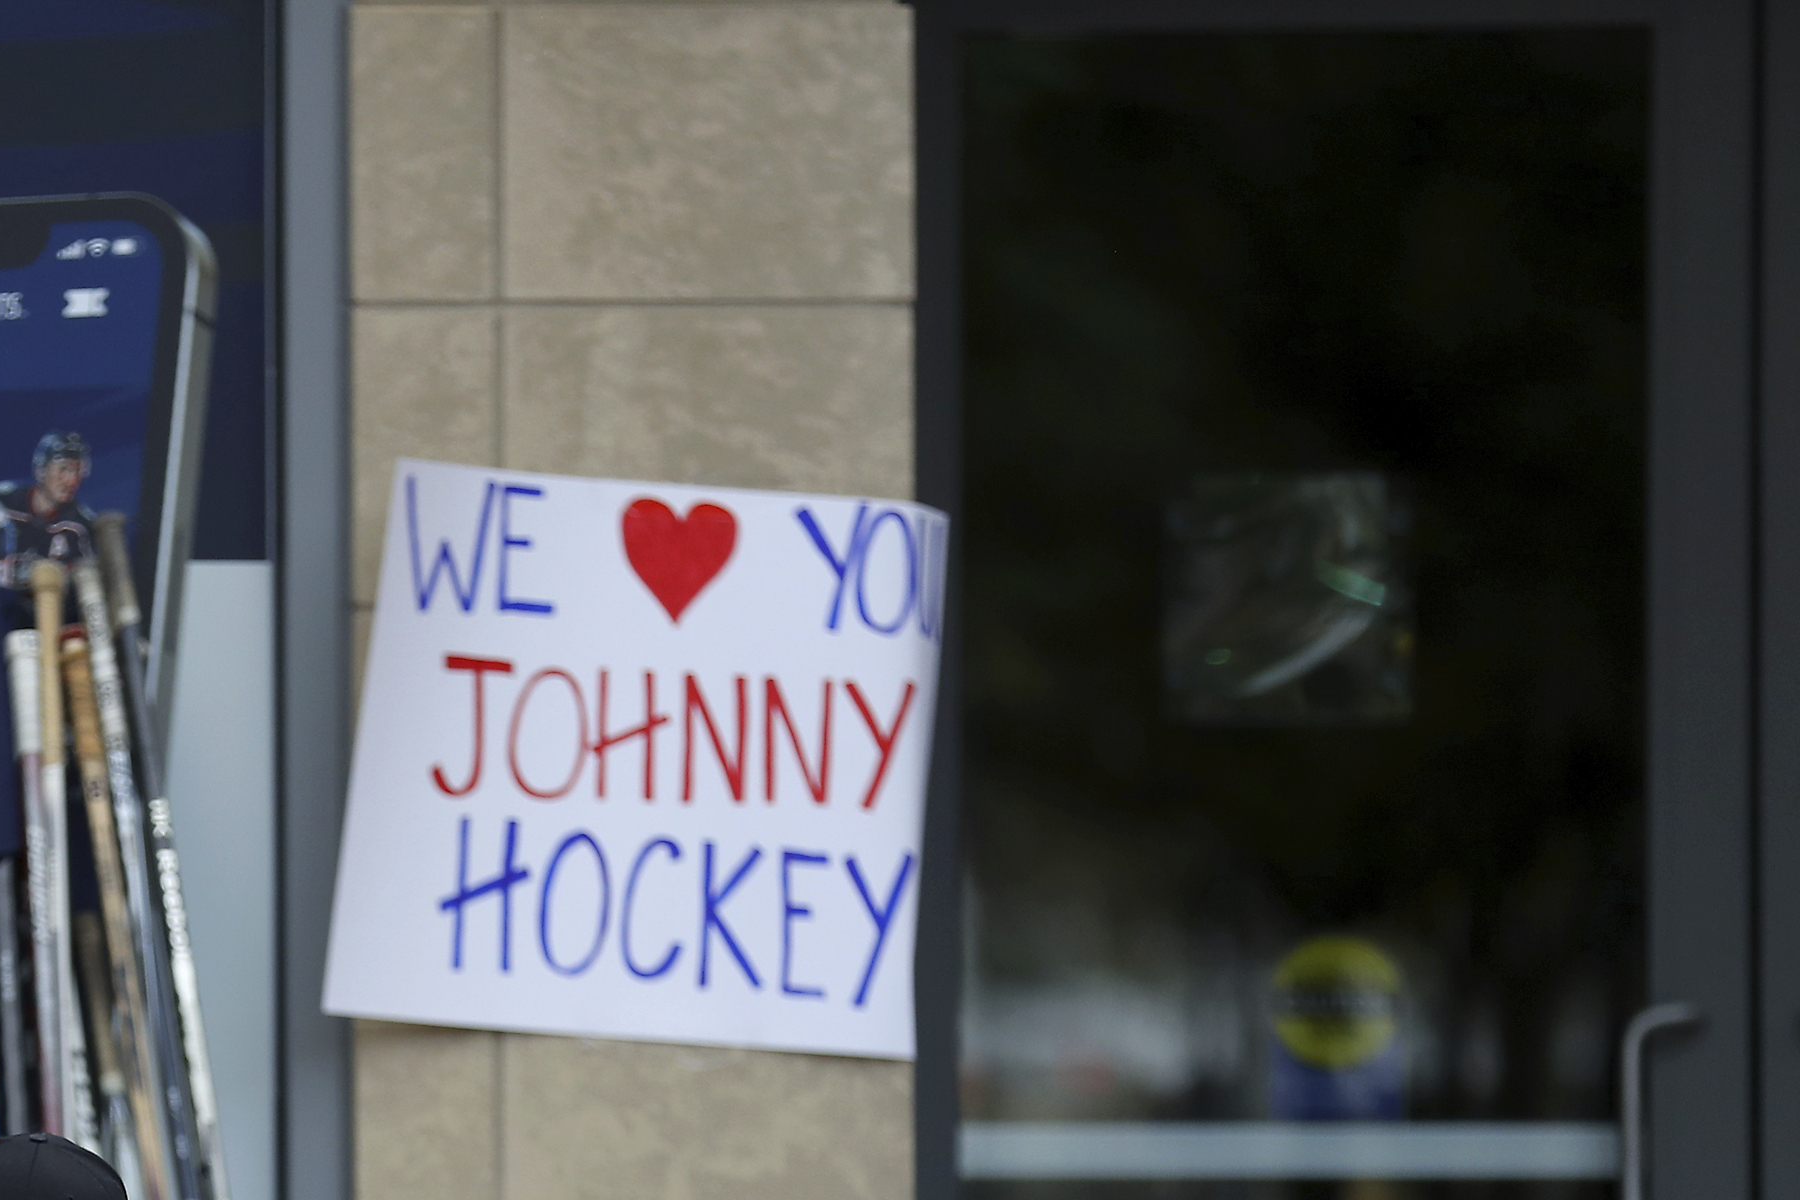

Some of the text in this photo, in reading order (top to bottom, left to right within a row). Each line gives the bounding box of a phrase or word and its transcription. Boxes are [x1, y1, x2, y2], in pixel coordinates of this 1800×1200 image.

[405, 474, 555, 615] WE
[430, 653, 917, 809] JOHNNY
[437, 815, 915, 1008] HOCKEY
